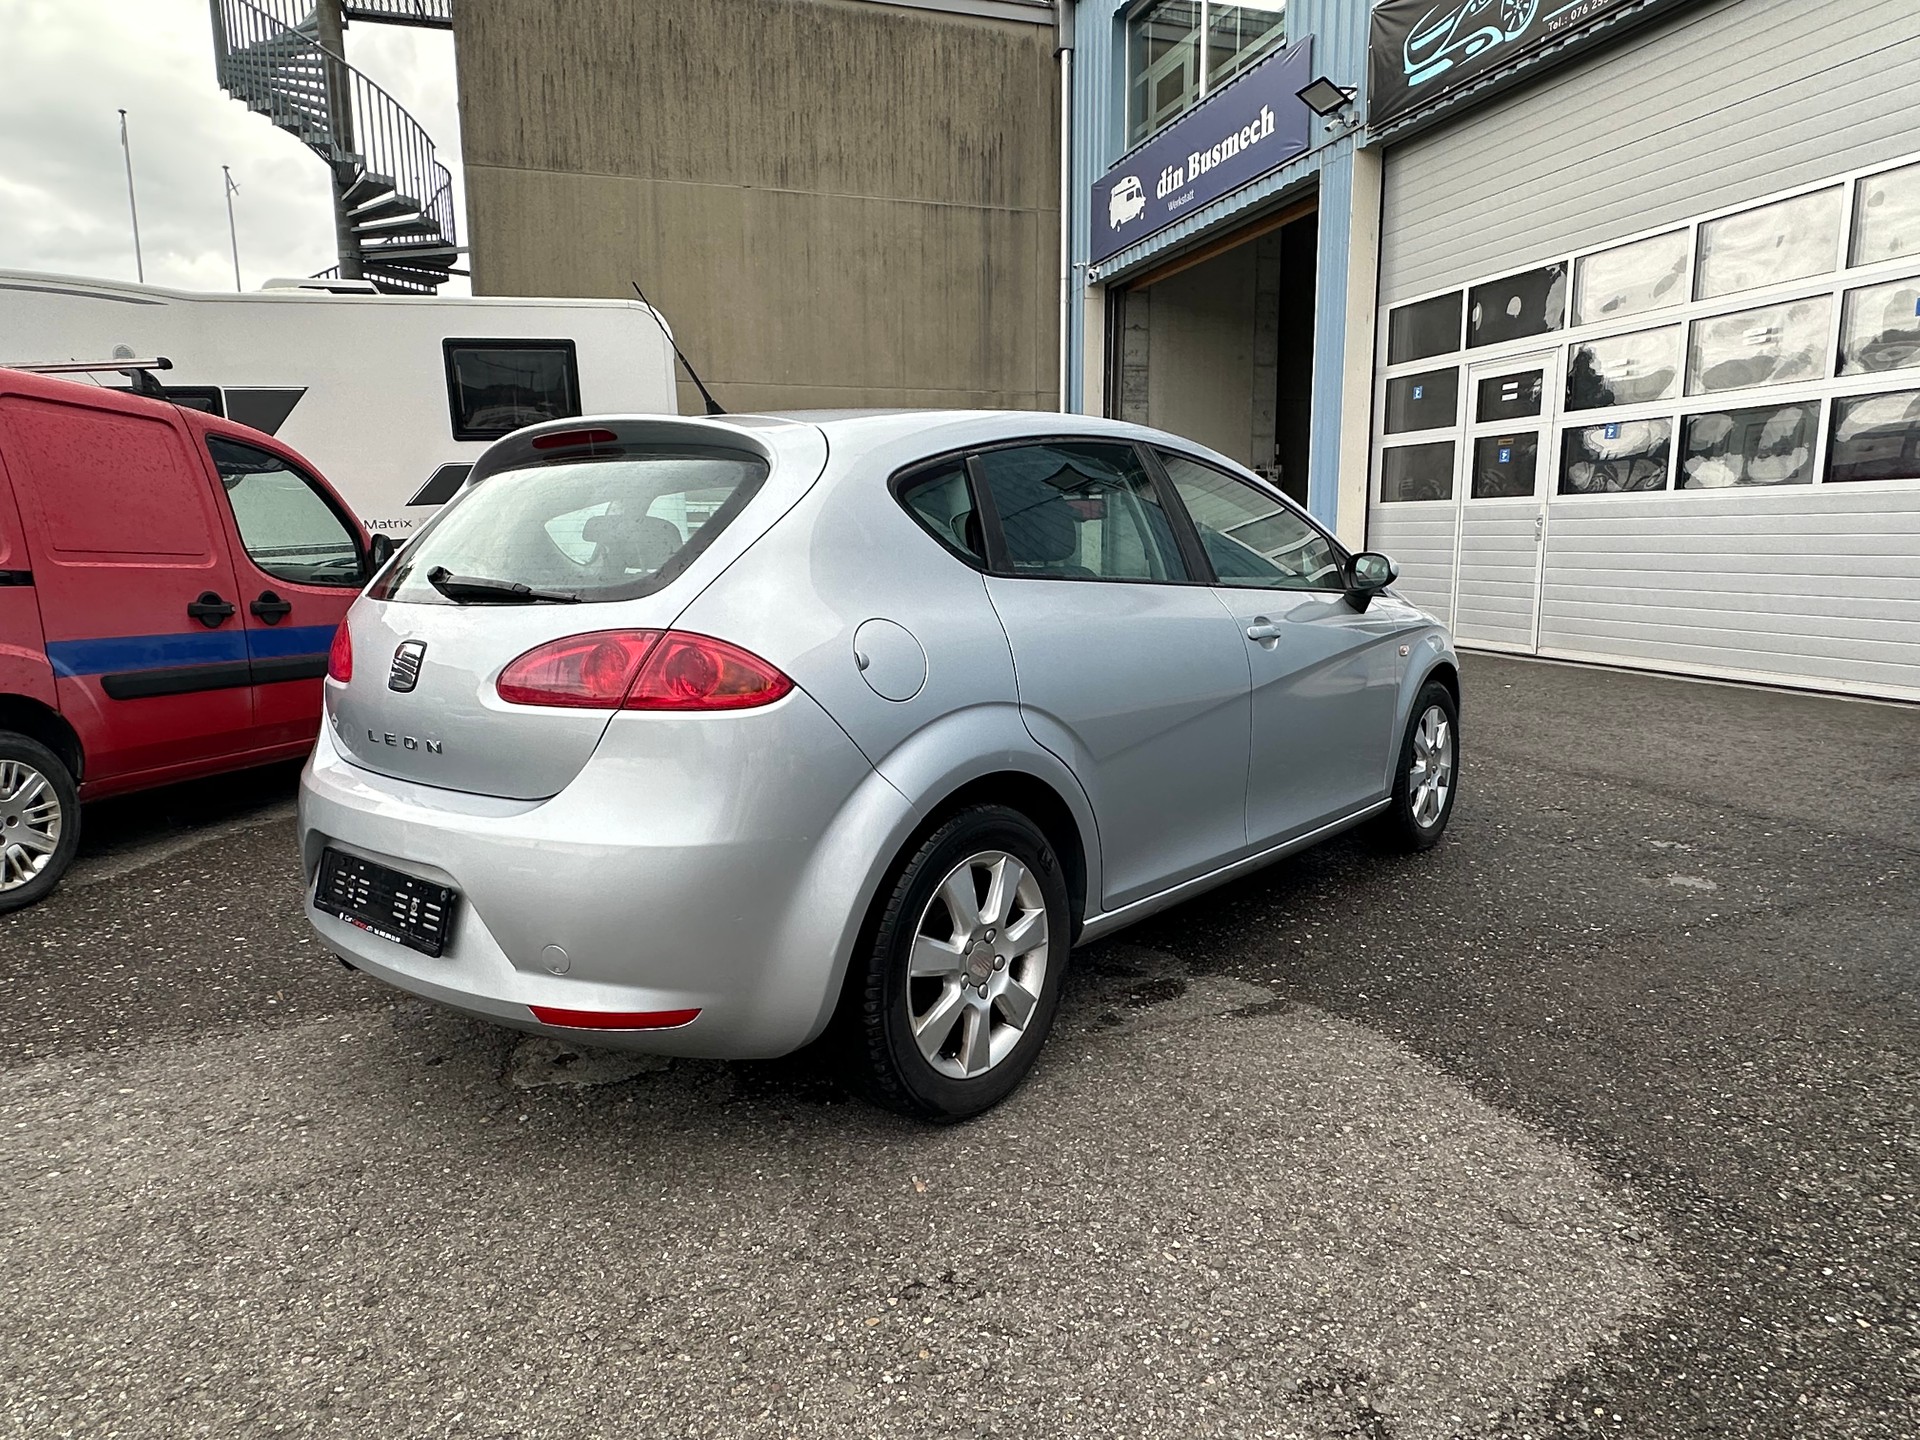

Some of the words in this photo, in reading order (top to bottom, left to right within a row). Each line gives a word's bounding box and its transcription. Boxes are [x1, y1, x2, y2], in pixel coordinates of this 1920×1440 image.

[1548, 17, 1568, 31] Tel.:
[1571, 3, 1588, 20] 076
[1157, 165, 1184, 199] din
[1187, 104, 1275, 182] Busmech
[1167, 190, 1195, 211] Werkstatt
[364, 518, 412, 529] Matrix
[368, 728, 442, 754] LEON
